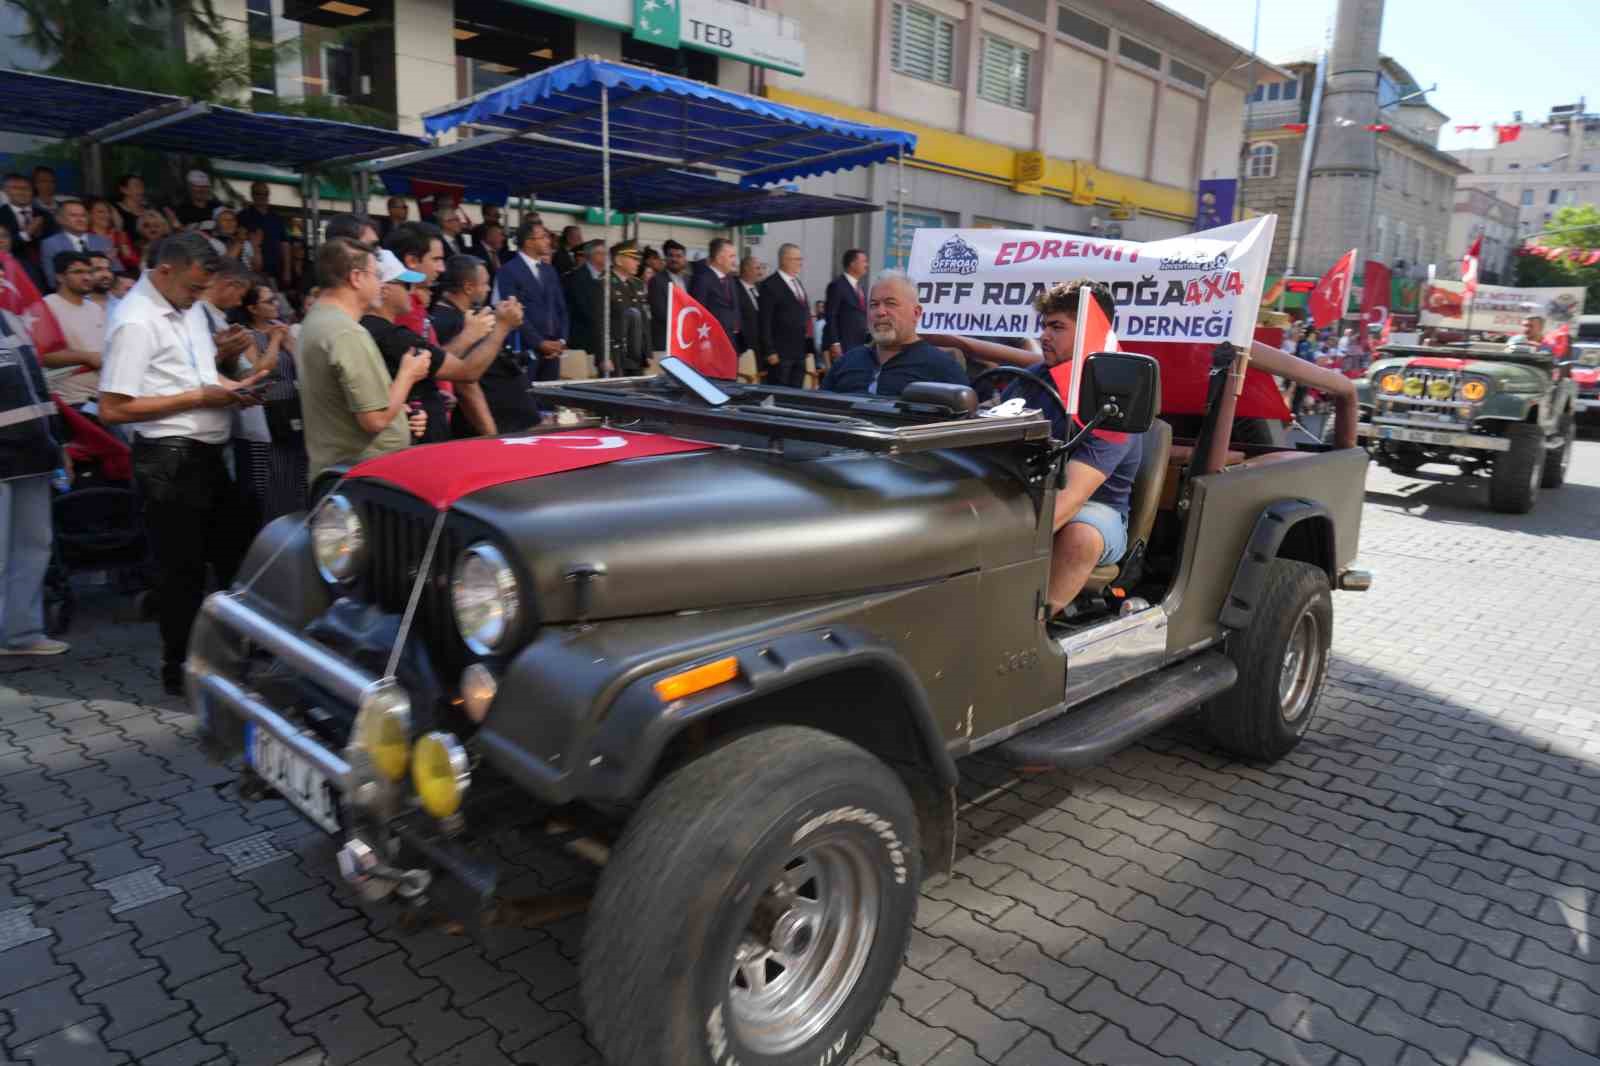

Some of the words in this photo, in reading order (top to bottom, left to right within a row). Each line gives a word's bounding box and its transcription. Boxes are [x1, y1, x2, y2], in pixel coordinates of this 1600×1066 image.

[689, 19, 733, 48] TEB
[916, 281, 977, 305] OFF
[980, 282, 1064, 306] ROA
[1102, 274, 1187, 306] OĞA
[920, 311, 1029, 333] UTKUNLARI
[1127, 309, 1233, 338] DERNEĞİ
